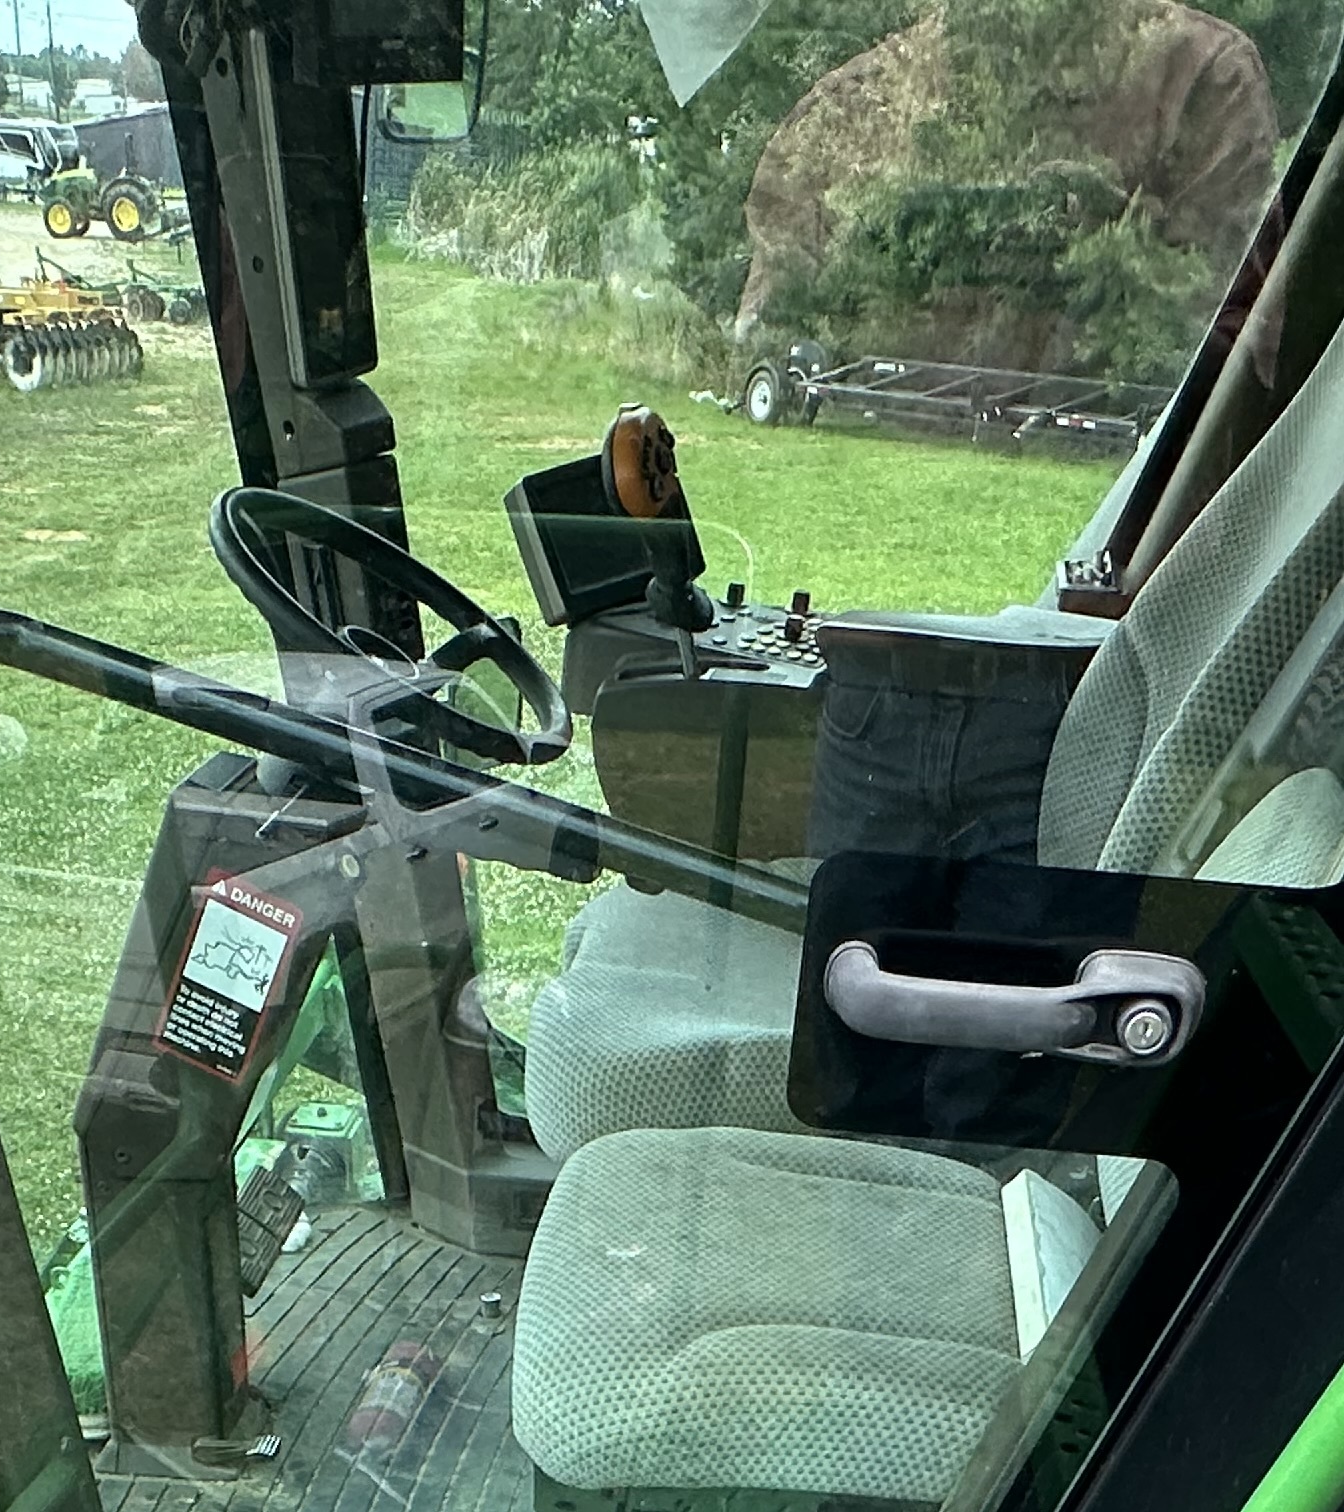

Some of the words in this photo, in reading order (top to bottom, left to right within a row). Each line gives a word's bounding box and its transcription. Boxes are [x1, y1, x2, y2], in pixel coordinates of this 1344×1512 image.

[230, 887, 296, 928] DANGER
[172, 1004, 205, 1024] contact
[190, 991, 215, 1007] avoid
[215, 1002, 240, 1020] injury
[166, 1022, 177, 1031] or
[176, 1027, 217, 1052] operating
[169, 1011, 191, 1028] lines
[190, 1023, 215, 1038] when
[214, 1033, 247, 1056] moving
[223, 1017, 239, 1030] not
